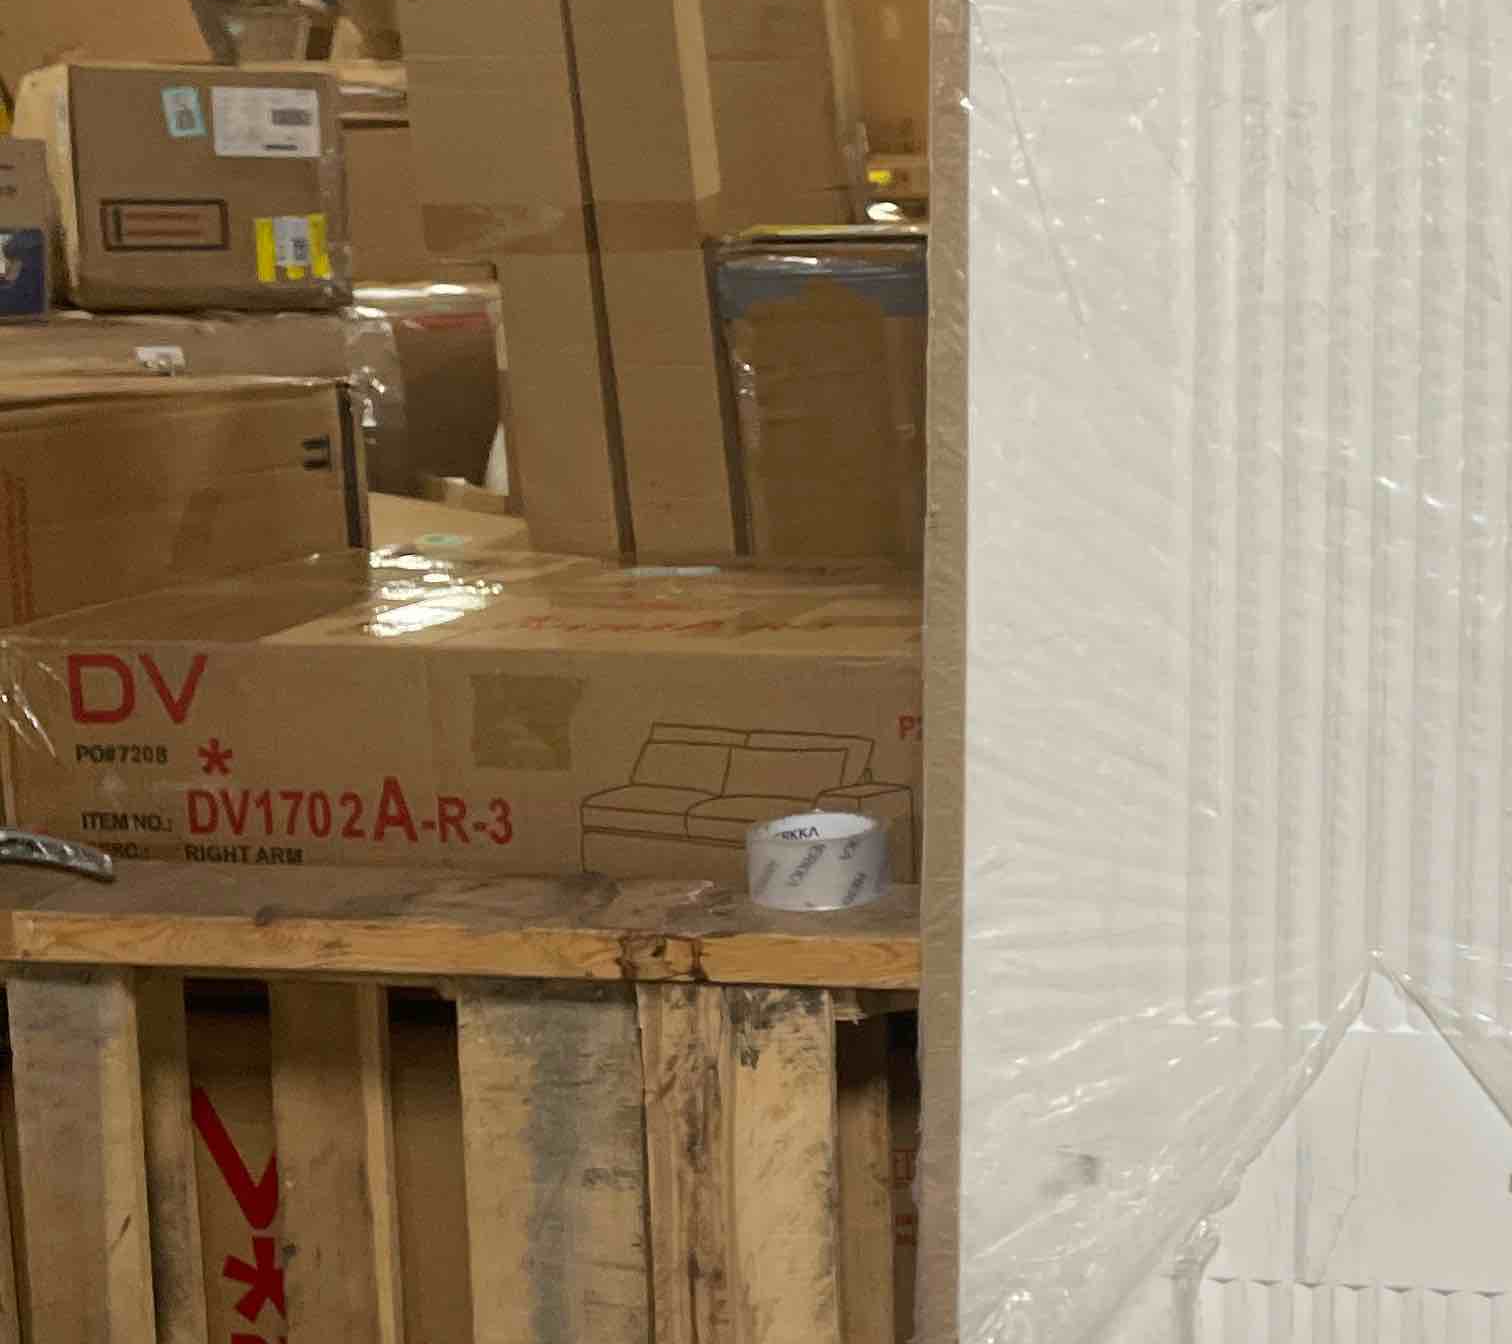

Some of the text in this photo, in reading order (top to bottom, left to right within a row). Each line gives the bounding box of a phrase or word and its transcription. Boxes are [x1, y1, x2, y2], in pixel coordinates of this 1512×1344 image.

[67, 652, 208, 724] DV
[81, 811, 129, 832] ITEM
[186, 775, 513, 844] DV1702A-R-3
[184, 844, 249, 863] RIGHT
[254, 846, 304, 865] ARM
